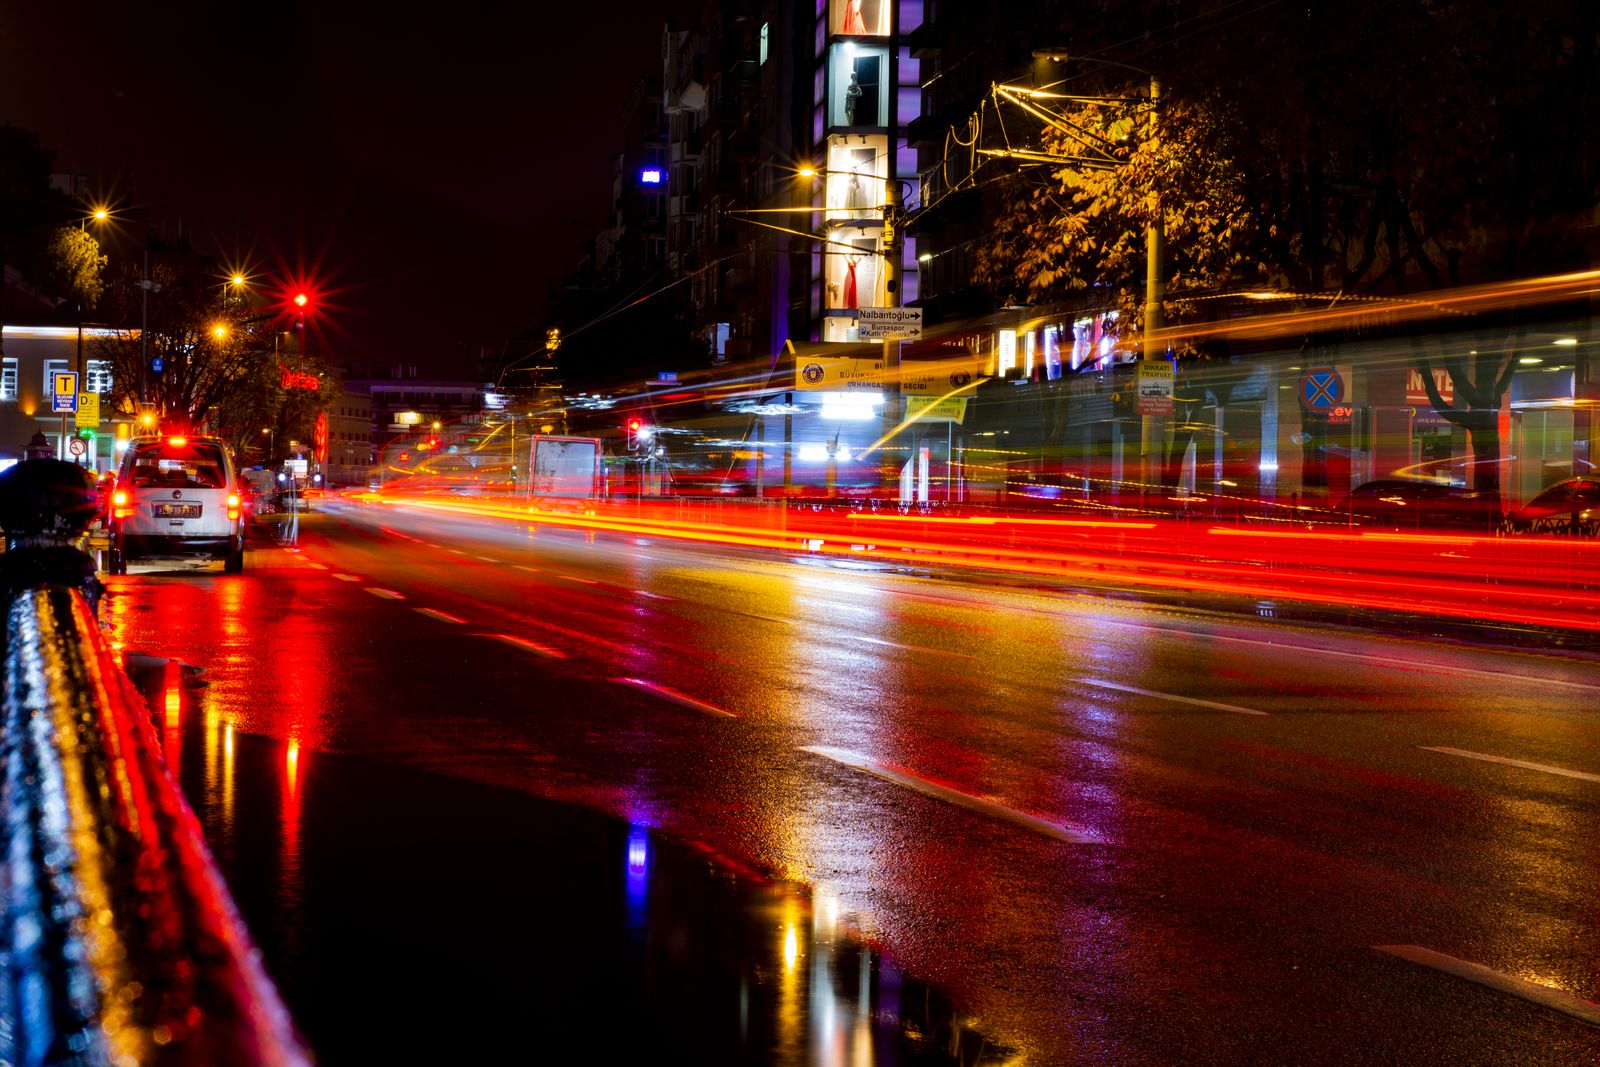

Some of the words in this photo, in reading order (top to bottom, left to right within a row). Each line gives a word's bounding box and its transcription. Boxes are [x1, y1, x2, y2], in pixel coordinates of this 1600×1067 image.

[860, 311, 910, 321] Nalbantoğlu
[872, 323, 904, 332] Bursaspor
[60, 377, 71, 391] T
